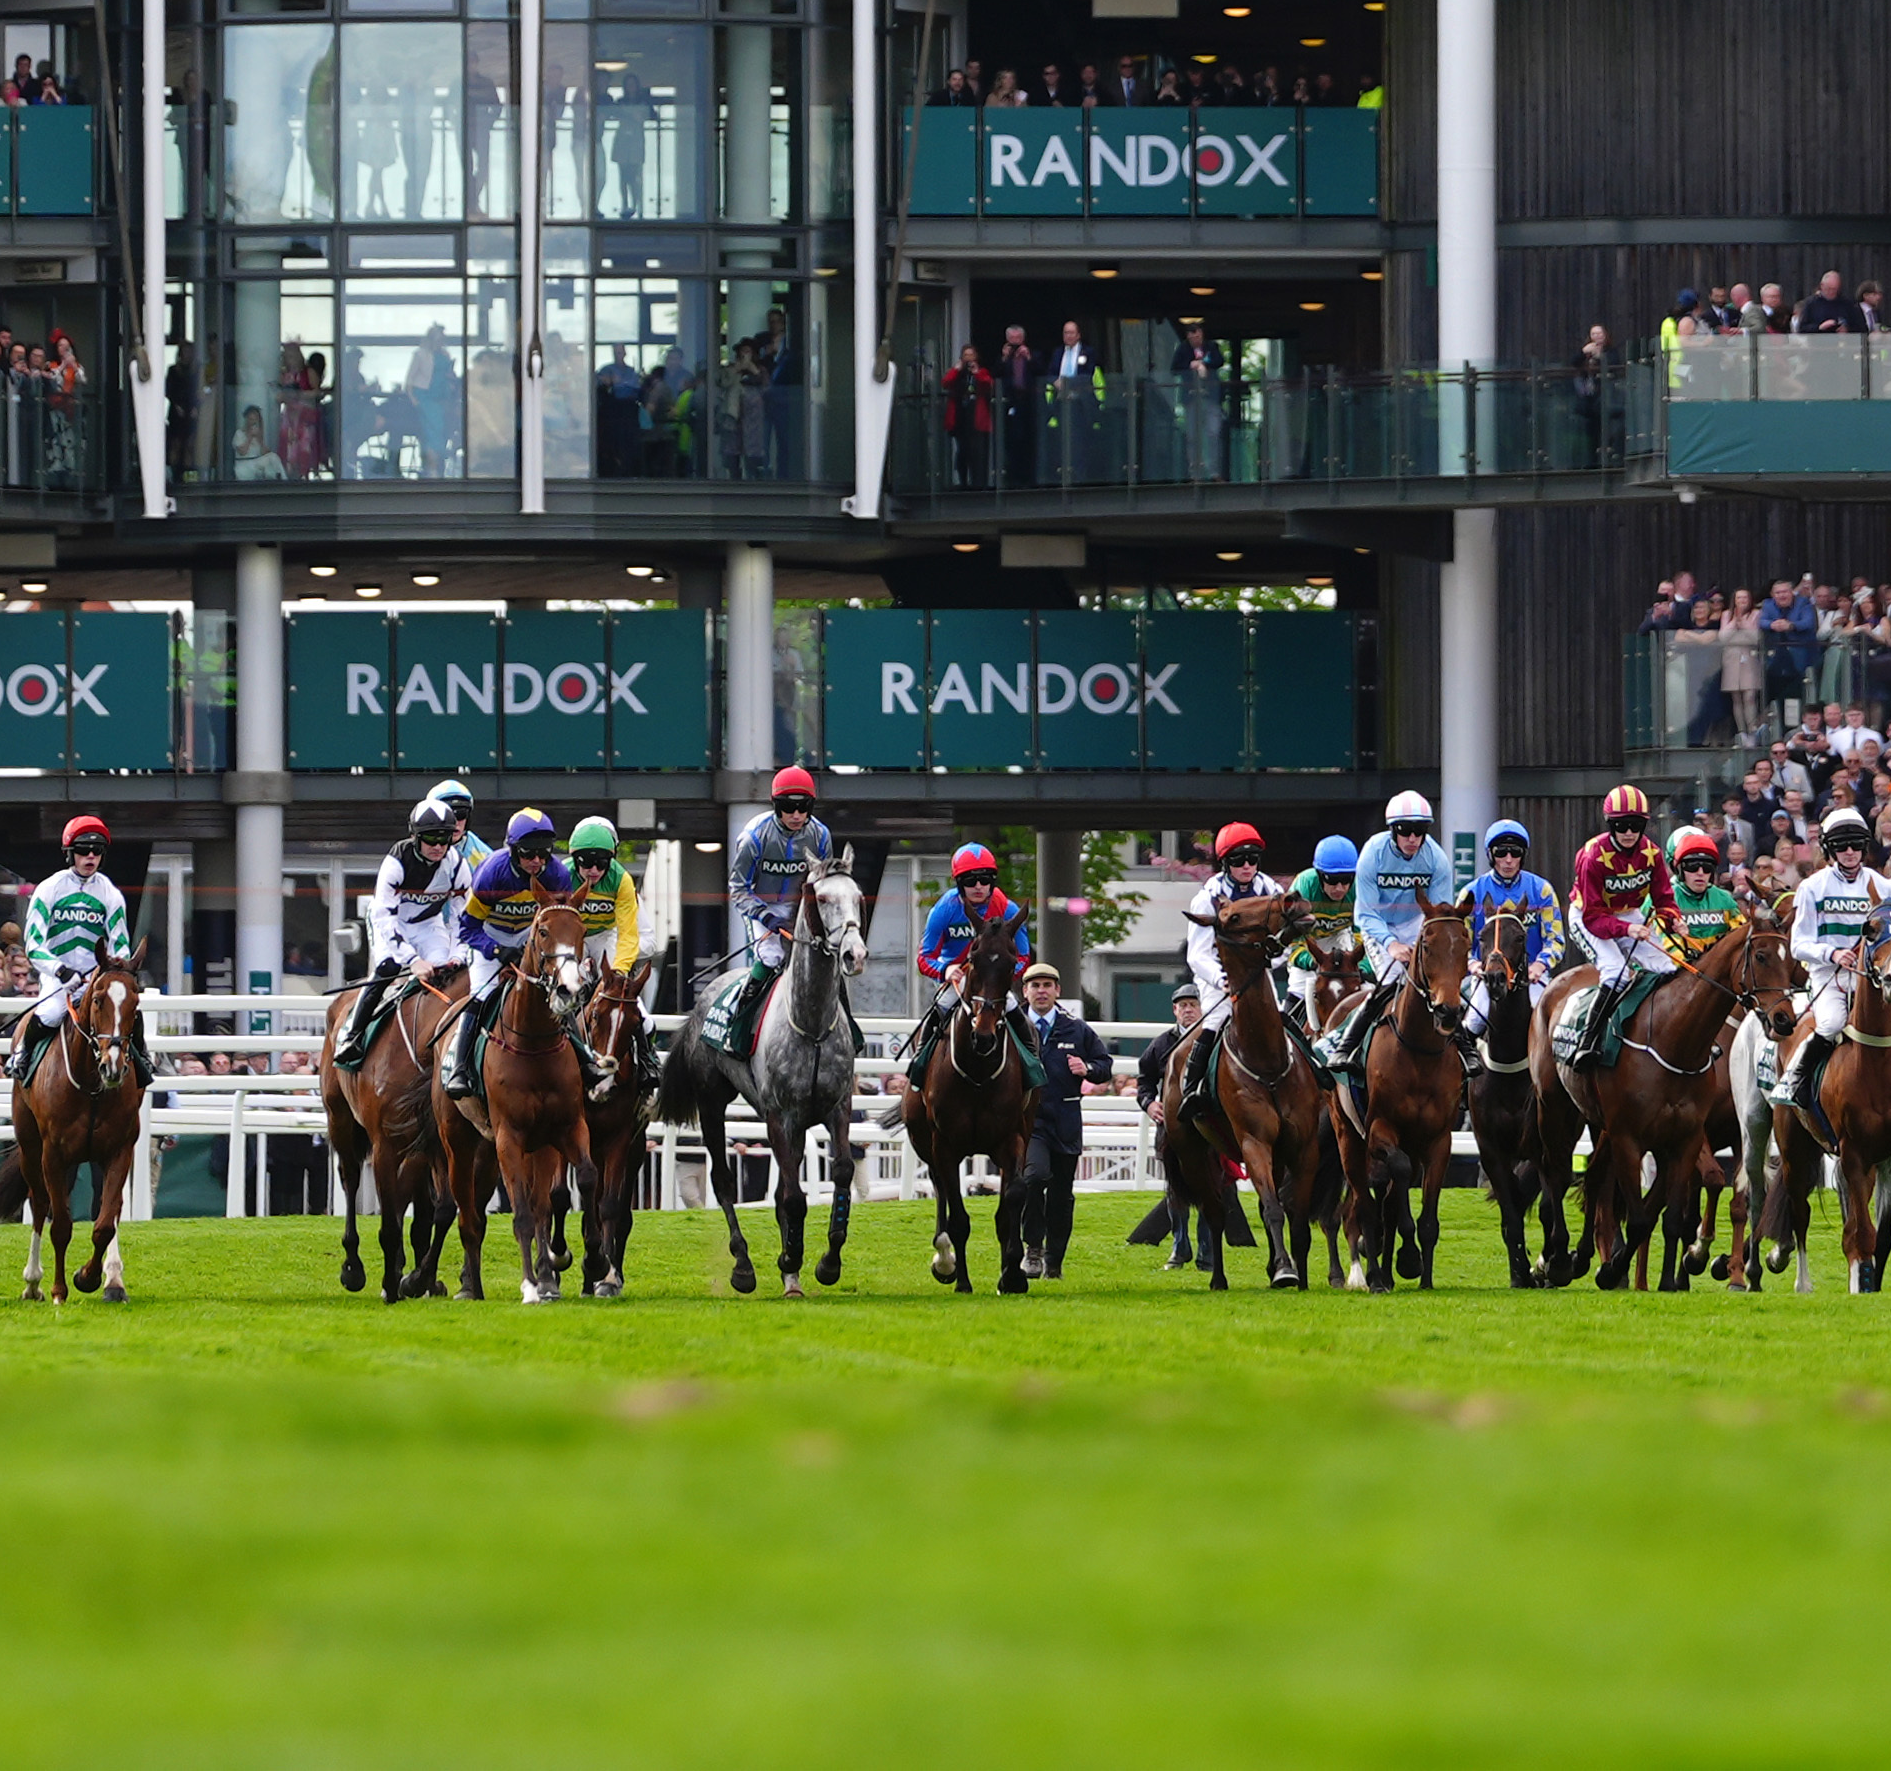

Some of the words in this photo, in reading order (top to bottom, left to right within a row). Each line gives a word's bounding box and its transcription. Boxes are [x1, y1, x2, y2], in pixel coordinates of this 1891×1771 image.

[991, 134, 1288, 187] RANDOX
[346, 662, 648, 715] RANDOX
[881, 662, 1182, 715] RANDOX
[763, 860, 808, 874] RANDO
[1376, 874, 1431, 887] RANDOX
[1604, 869, 1652, 891] RANDOX
[400, 890, 447, 904] ANDOX
[495, 902, 540, 916] RANDO
[1824, 899, 1871, 913] RANDO
[53, 909, 105, 925] RANDOX
